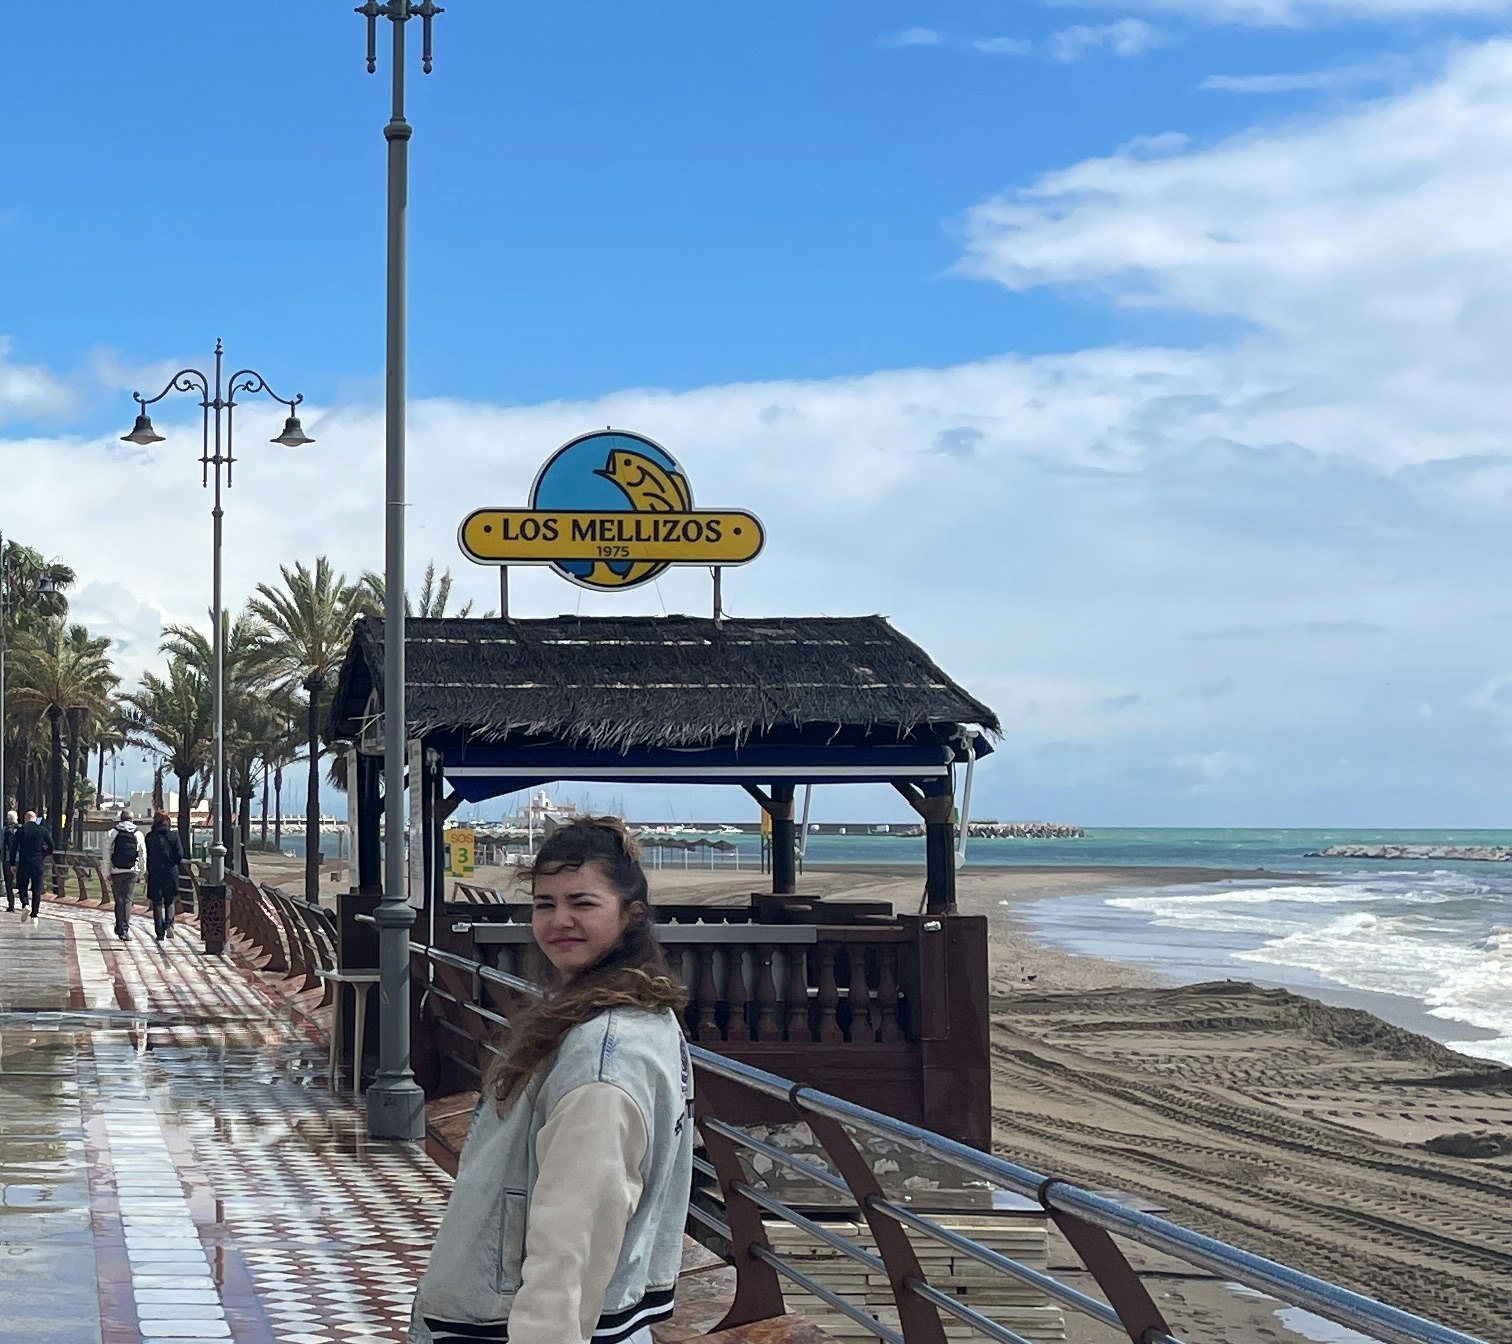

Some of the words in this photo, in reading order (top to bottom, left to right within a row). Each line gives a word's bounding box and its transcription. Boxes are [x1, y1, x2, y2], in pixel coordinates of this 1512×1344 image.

[502, 518, 559, 541] LOS
[571, 519, 722, 543] MELLIZOS
[596, 545, 630, 557] 1975
[450, 833, 473, 844] SOS
[457, 847, 469, 864] 3
